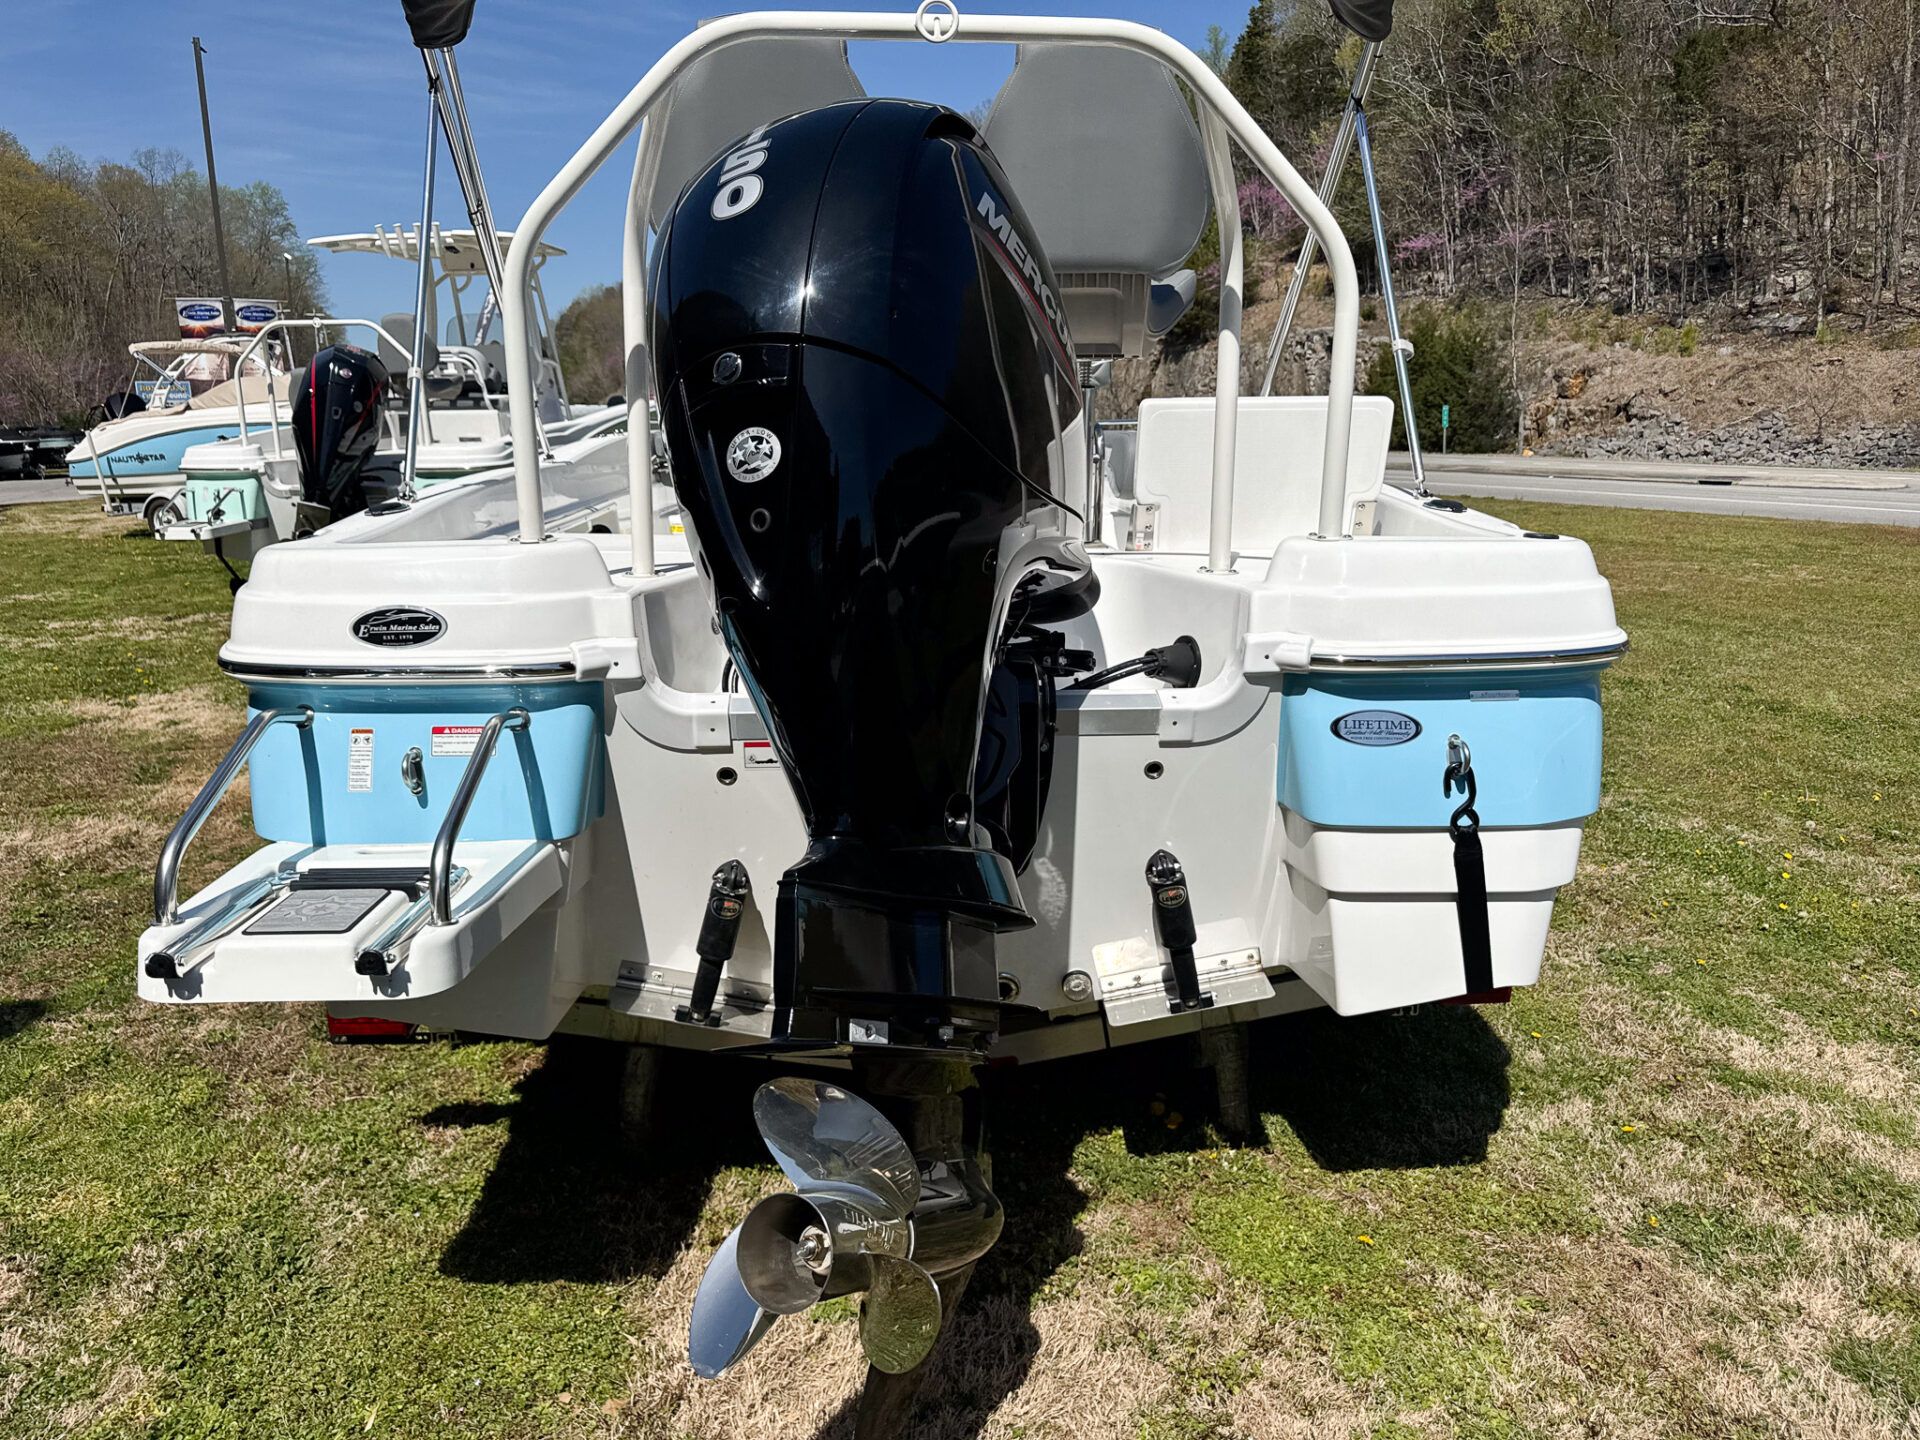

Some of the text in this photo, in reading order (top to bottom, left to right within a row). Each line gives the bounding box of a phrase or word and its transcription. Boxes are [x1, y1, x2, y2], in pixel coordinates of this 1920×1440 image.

[756, 429, 773, 439] LOW
[358, 624, 387, 637] Erwin
[418, 623, 440, 631] Sales
[1343, 719, 1412, 730] LIFETIME
